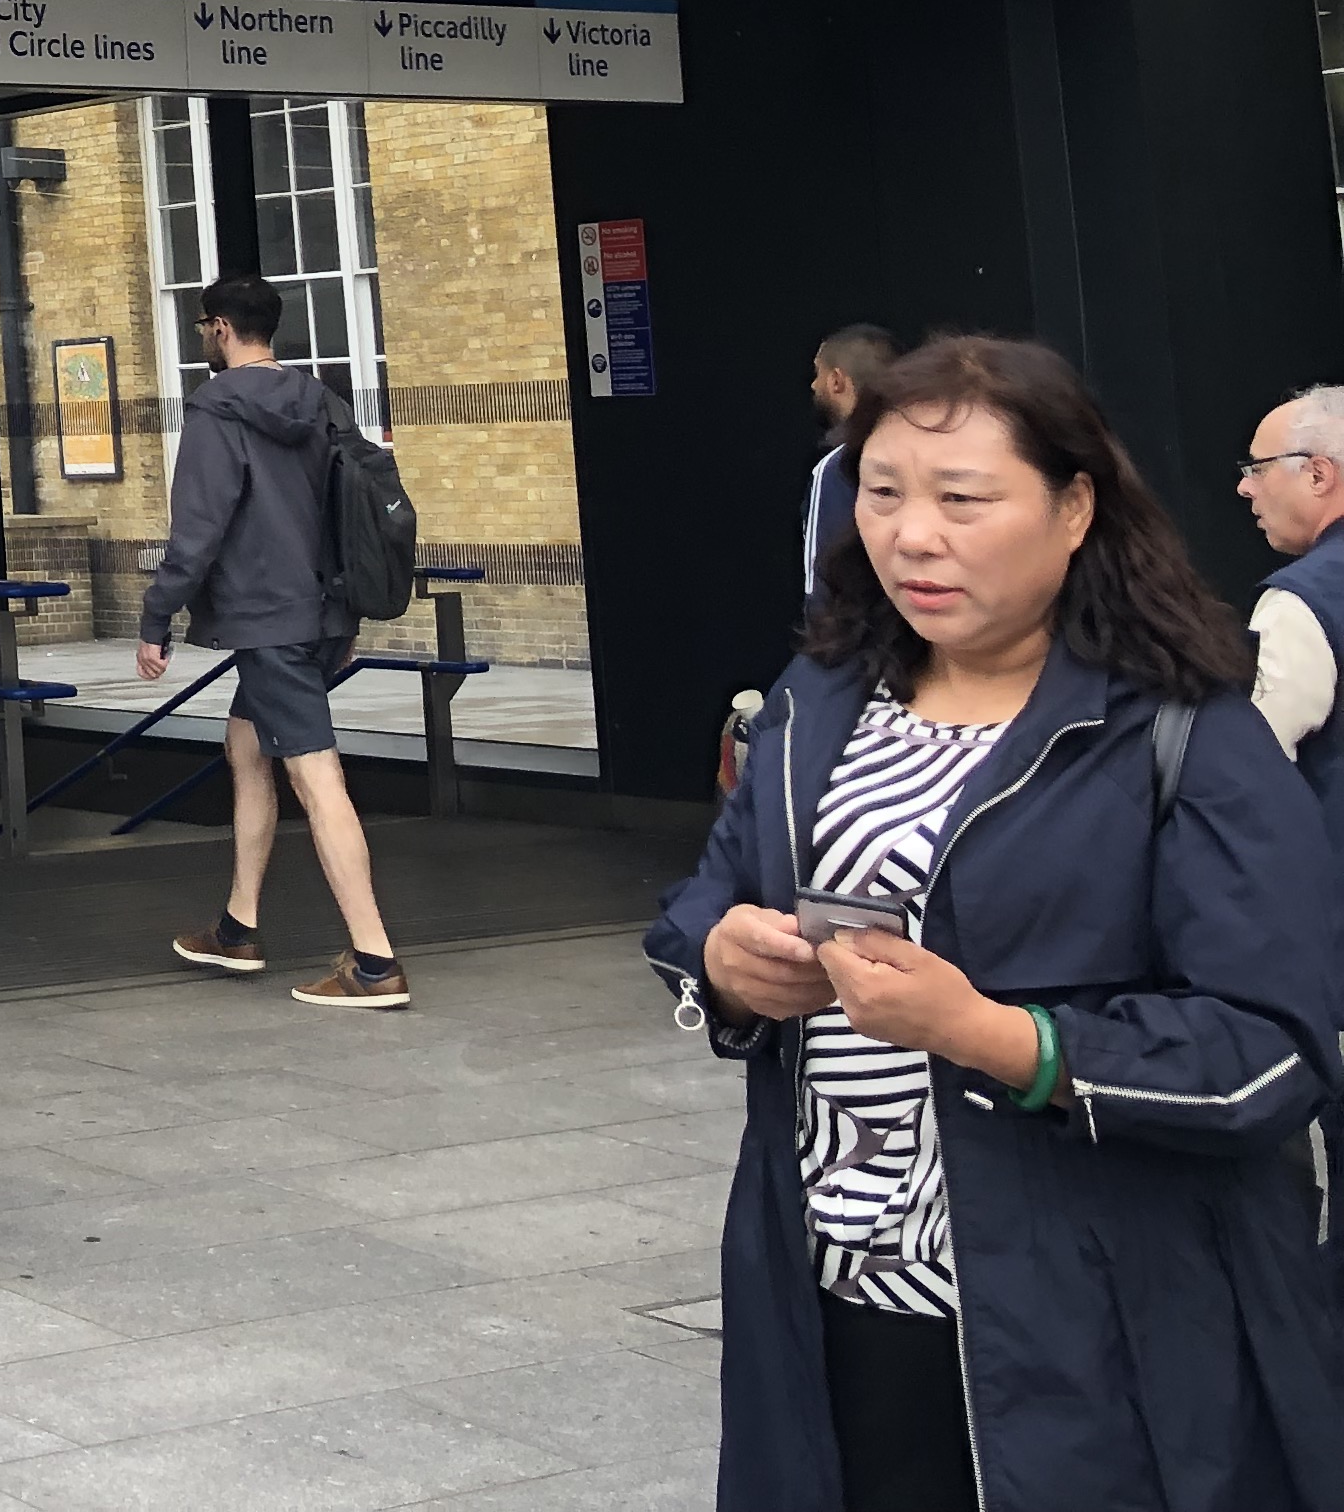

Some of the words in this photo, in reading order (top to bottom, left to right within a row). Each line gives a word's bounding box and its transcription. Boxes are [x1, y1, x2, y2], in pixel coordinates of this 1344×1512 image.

[220, 5, 334, 35] Northern
[398, 11, 508, 47] Piccadilly
[565, 20, 652, 47] Victoria
[9, 30, 85, 59] Circle
[94, 33, 155, 61] lines
[221, 39, 267, 66] line
[400, 45, 444, 71] line
[568, 52, 609, 77] line
